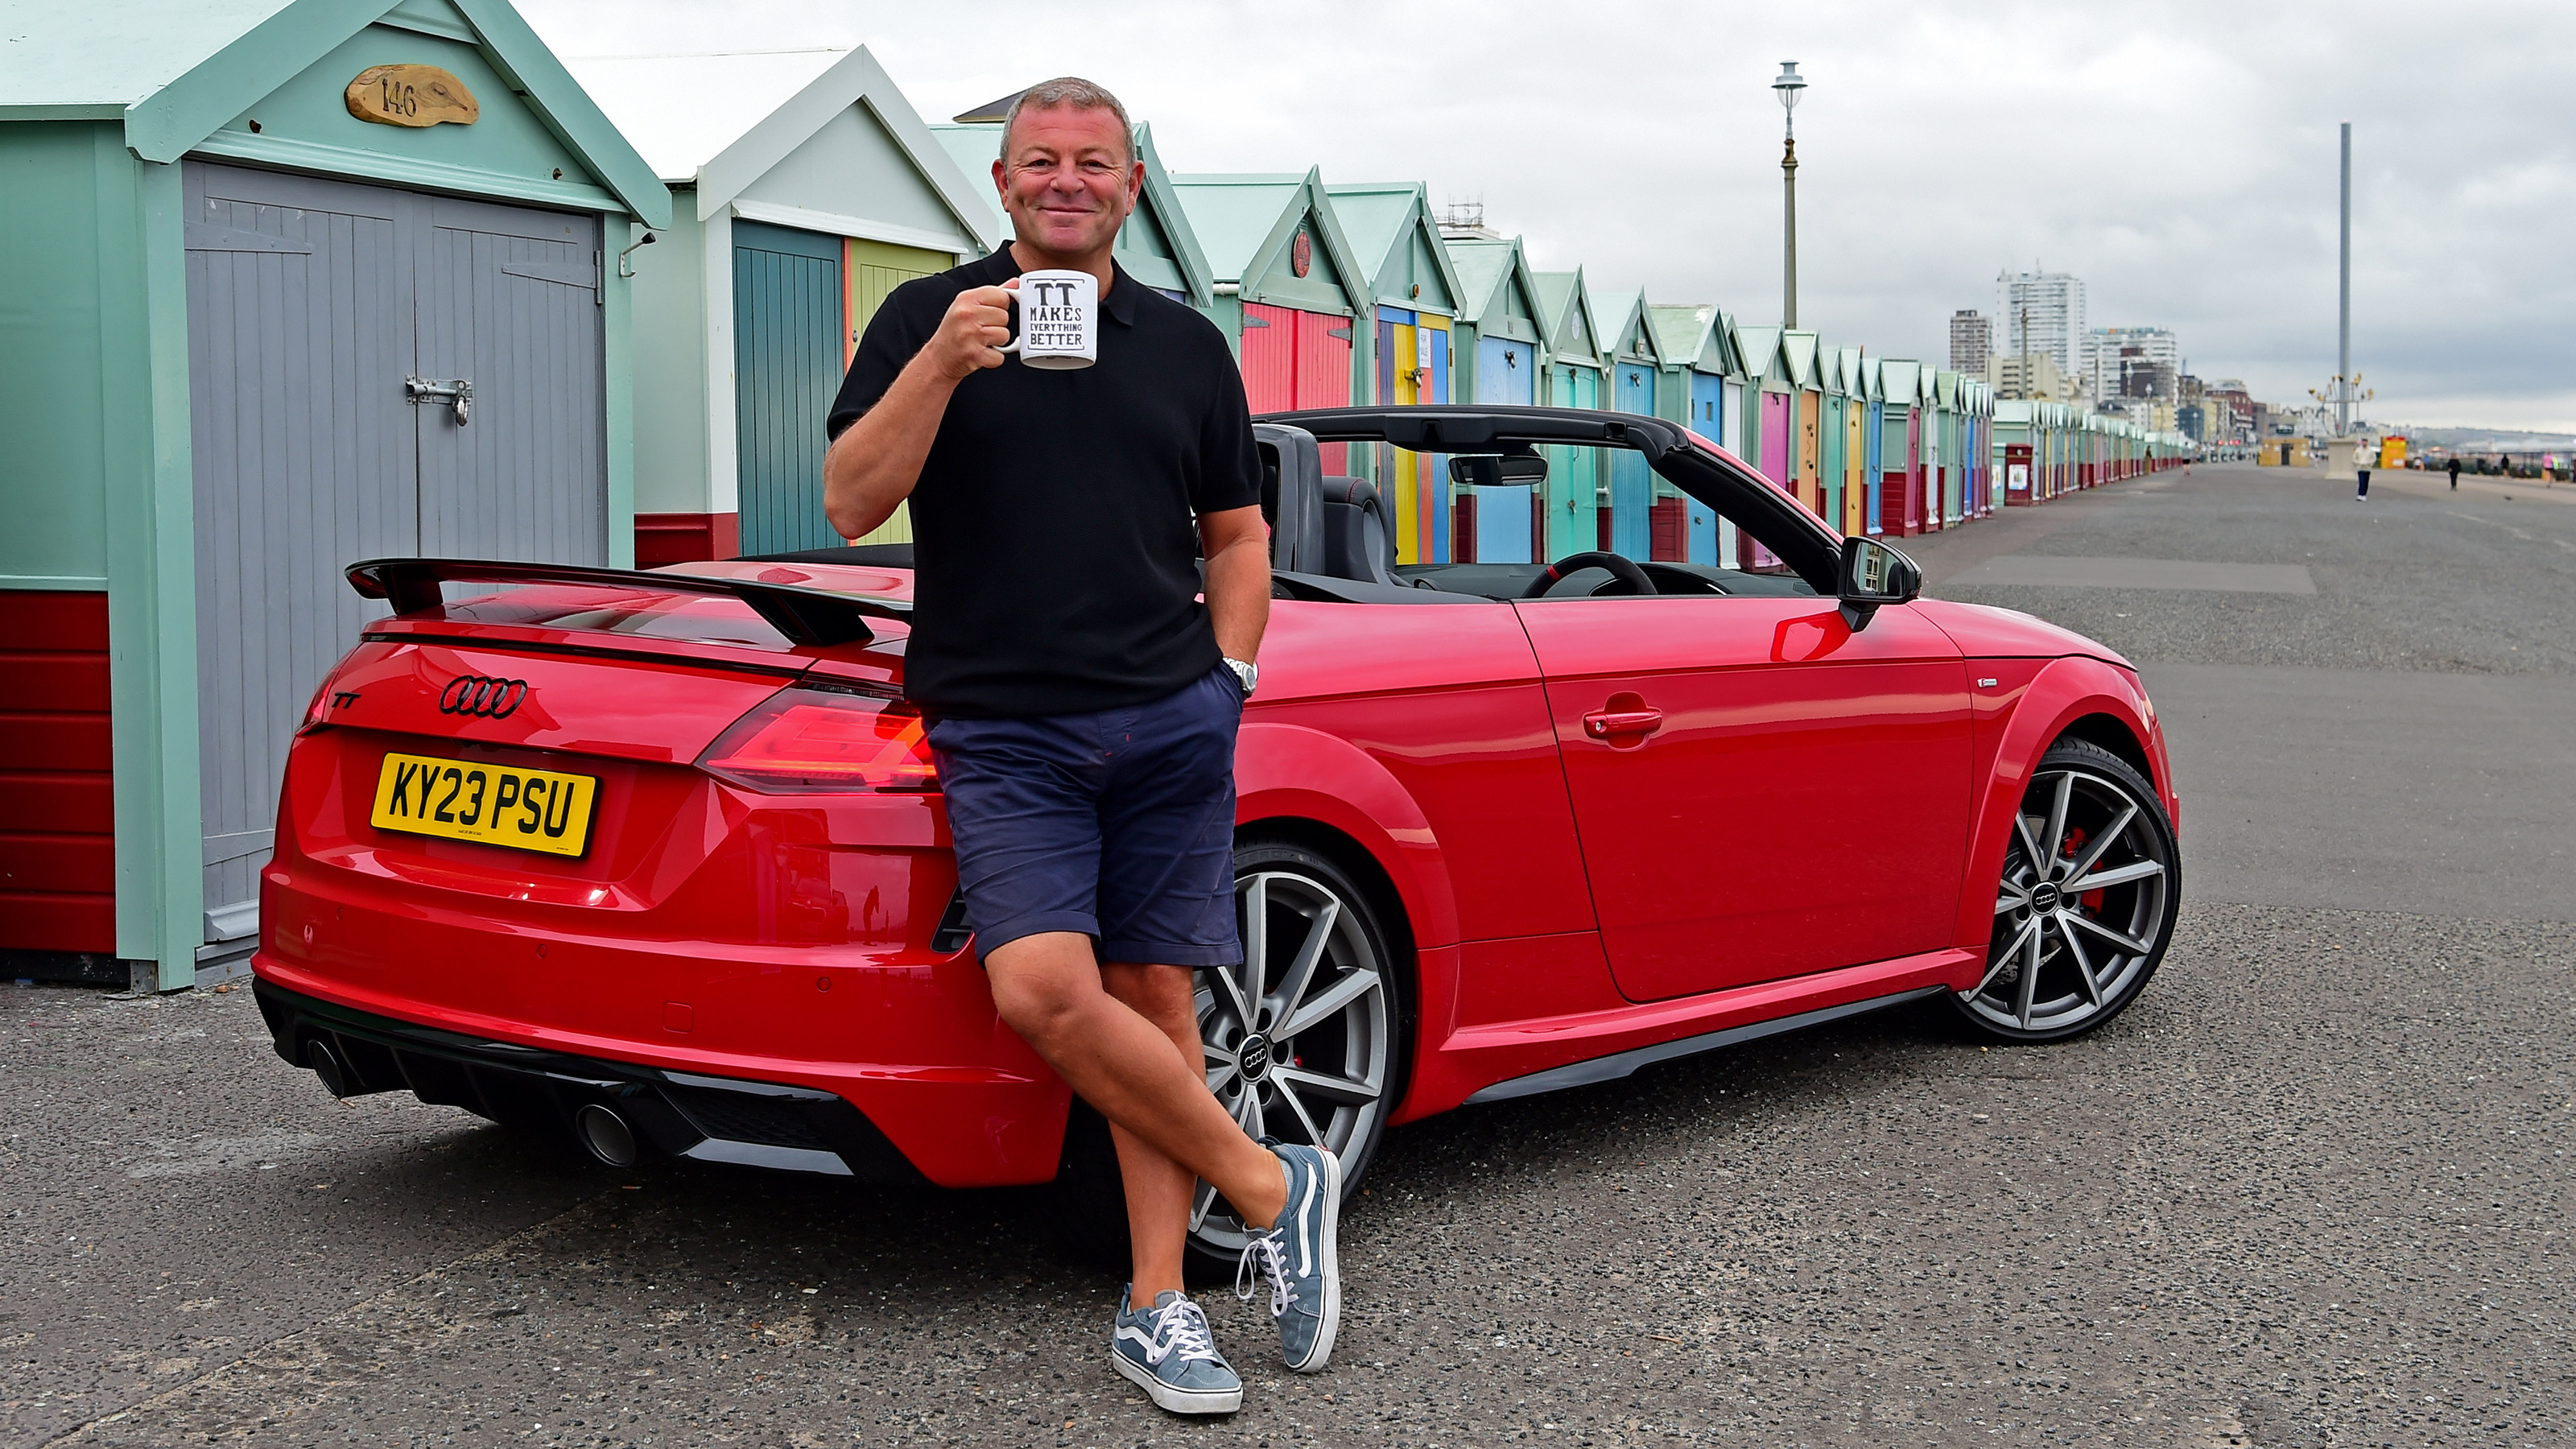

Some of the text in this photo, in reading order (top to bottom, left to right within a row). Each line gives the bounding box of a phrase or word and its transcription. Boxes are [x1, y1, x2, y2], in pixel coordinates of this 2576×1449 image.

[382, 78, 417, 118] 146
[1034, 283, 1077, 306] TT
[1030, 308, 1082, 321] MAKES
[1030, 323, 1082, 332] EVERYTHING
[1030, 333, 1082, 345] BETTER
[331, 691, 361, 709] TT
[389, 762, 575, 839] KY23 PSU
